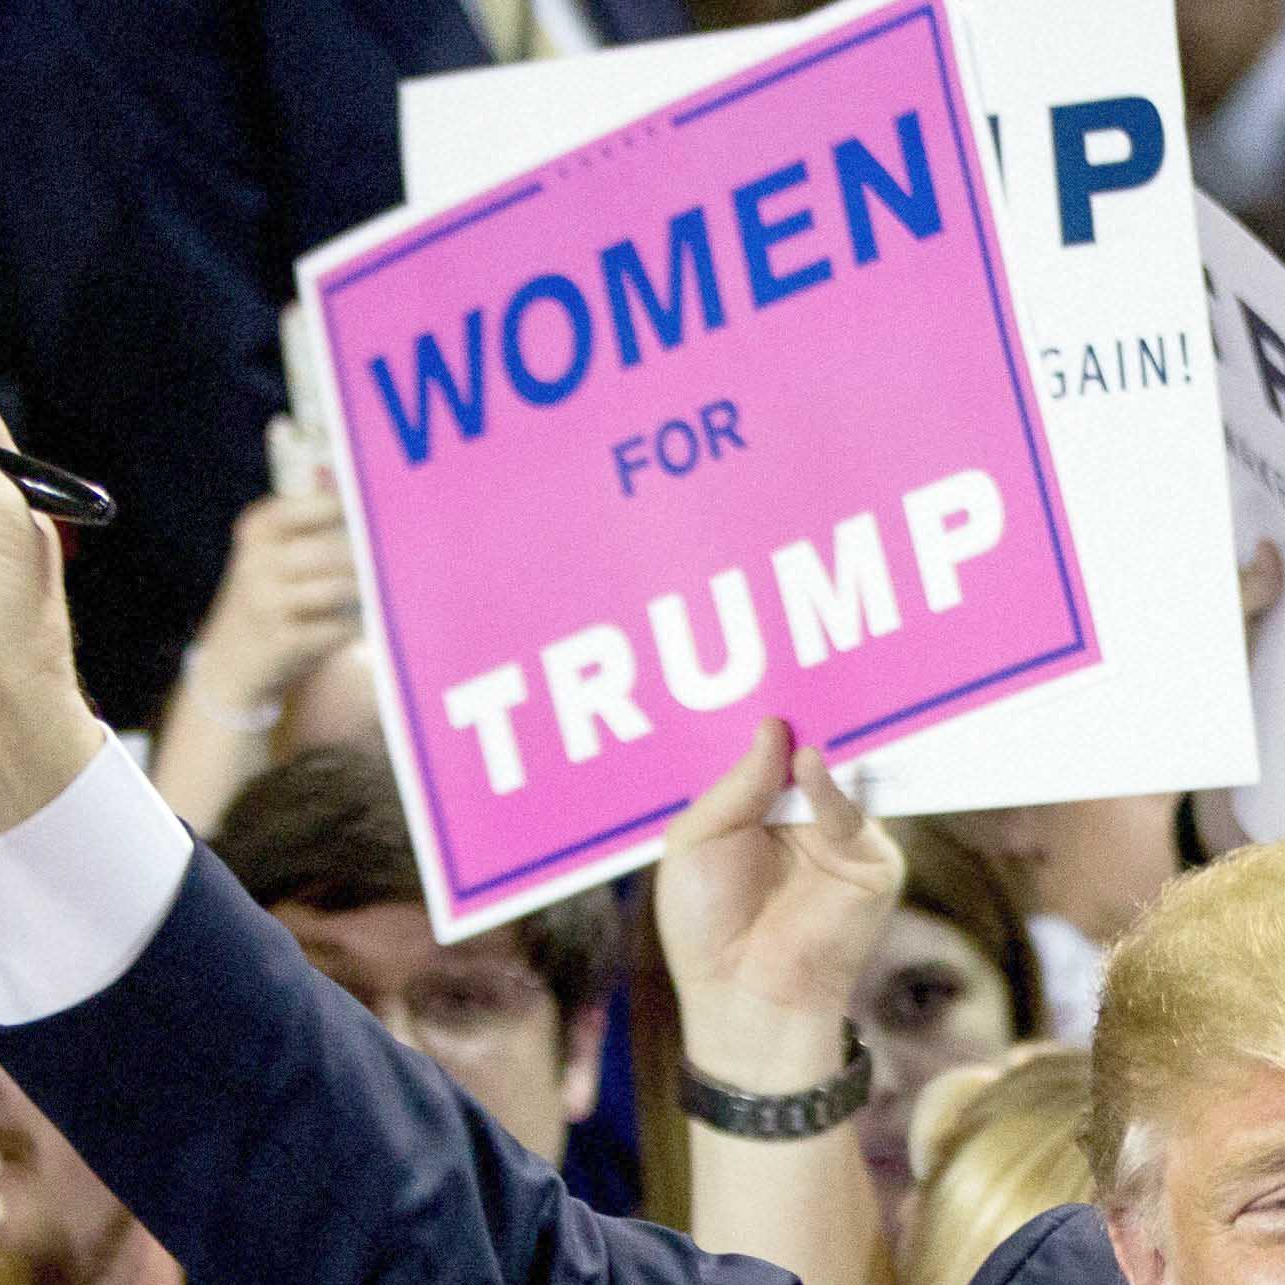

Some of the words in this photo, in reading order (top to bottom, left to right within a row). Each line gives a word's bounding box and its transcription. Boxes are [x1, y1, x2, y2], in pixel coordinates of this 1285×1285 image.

[366, 110, 946, 469] WOMEN
[1040, 332, 1192, 399] GAIN!
[610, 397, 748, 498] FOR
[443, 467, 1007, 797] TRUMP
